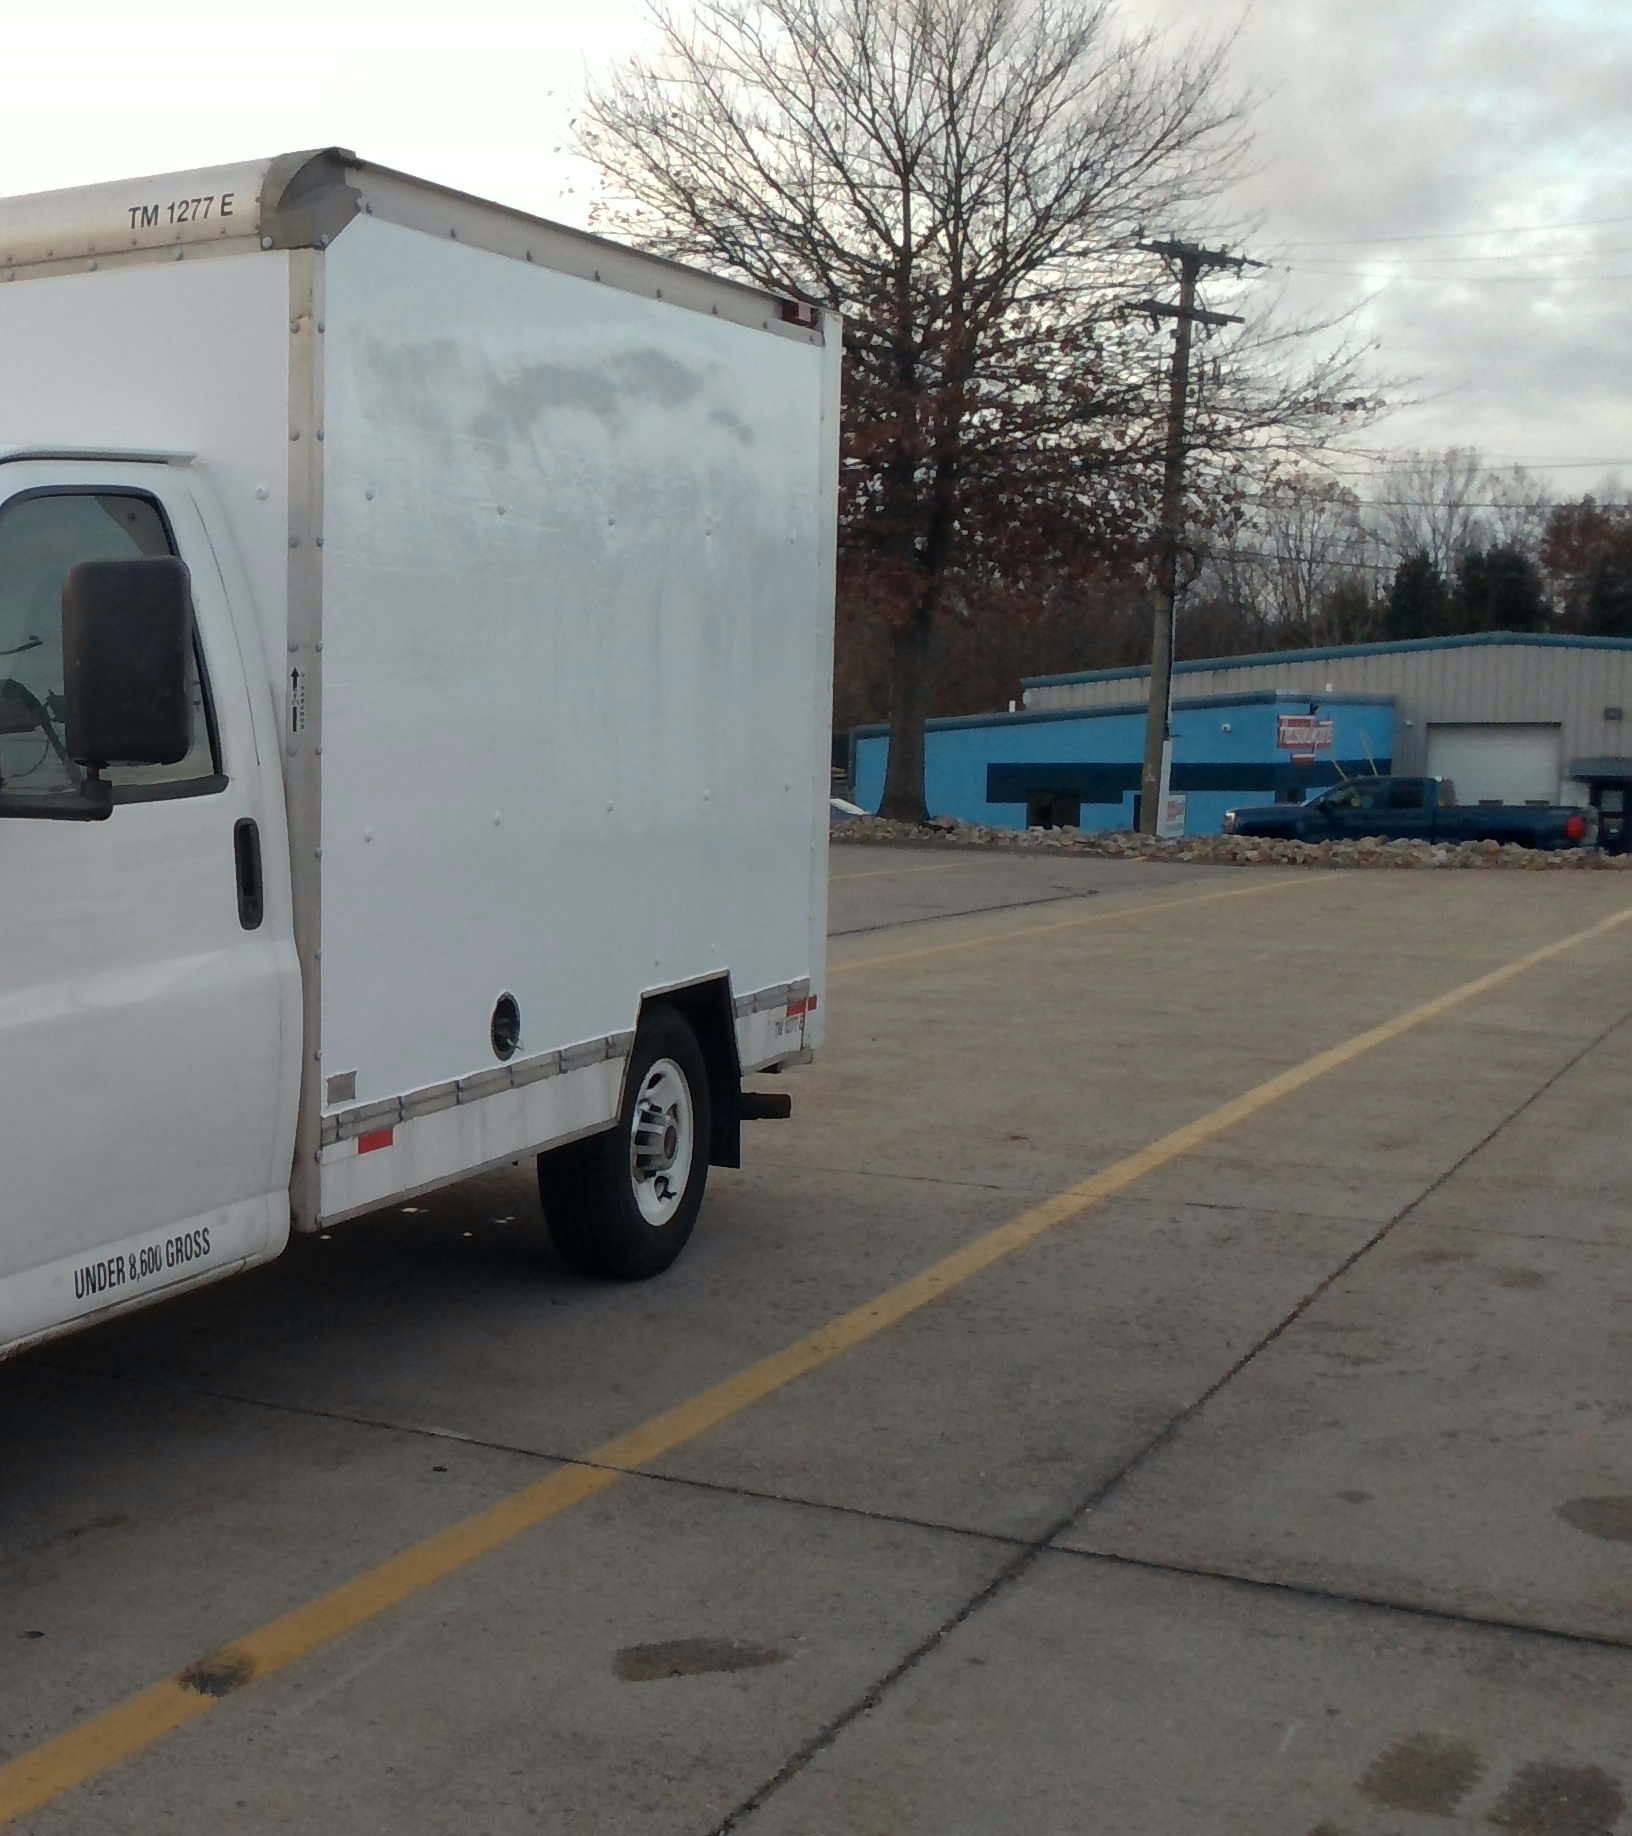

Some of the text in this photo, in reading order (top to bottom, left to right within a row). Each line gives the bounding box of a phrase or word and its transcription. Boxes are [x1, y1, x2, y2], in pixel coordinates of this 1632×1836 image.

[128, 193, 234, 229] TM 1277 E
[74, 1227, 211, 1299] UNDER 8,600 GROSS
